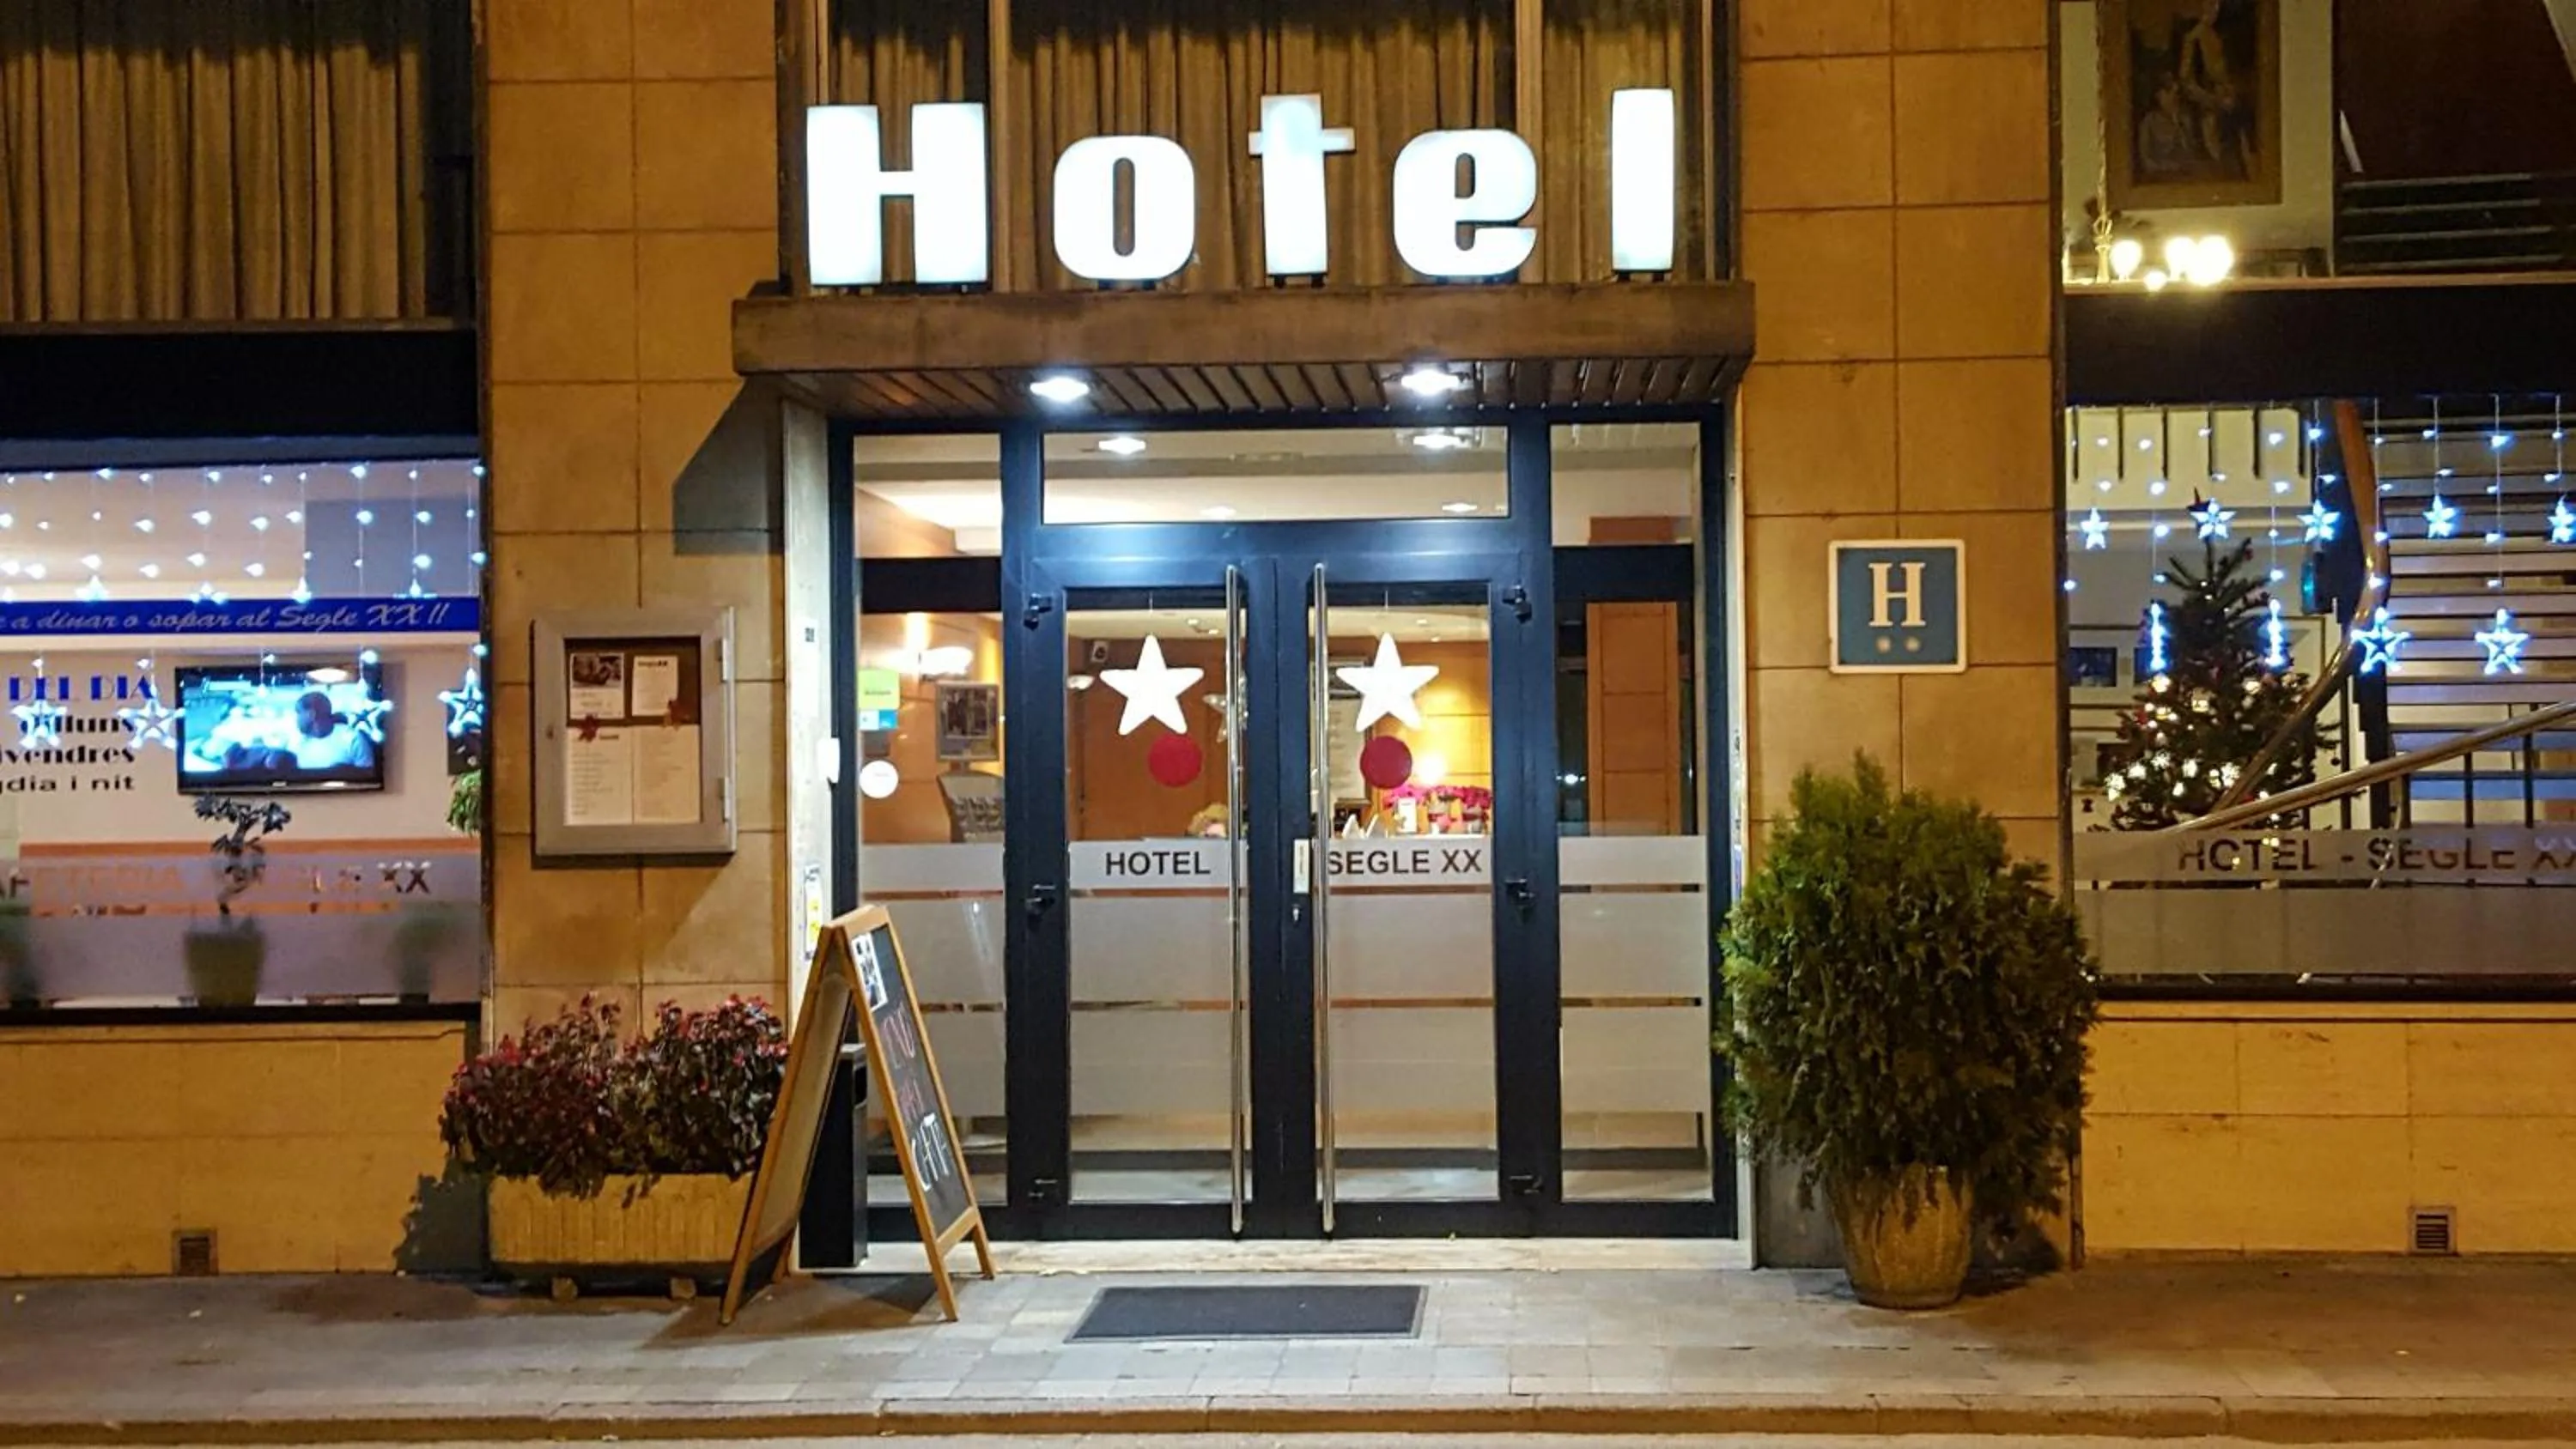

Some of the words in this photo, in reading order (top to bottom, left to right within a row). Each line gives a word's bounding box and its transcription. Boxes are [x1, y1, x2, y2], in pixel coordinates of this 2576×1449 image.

[806, 87, 1674, 285] Hotel
[1868, 562, 1927, 627] H
[11, 615, 31, 629] a
[36, 609, 120, 629] dinar
[123, 614, 140, 628] o
[148, 610, 232, 633] sopar
[235, 604, 271, 627] al
[274, 603, 358, 634] Segle
[9, 676, 82, 701] DEL
[0, 744, 136, 764] vendres
[0, 775, 57, 795] dia
[91, 775, 136, 791] nit
[1105, 851, 1211, 876] HOTEL
[1327, 849, 1431, 875] SEGLE
[1440, 848, 1482, 874] XX
[2178, 837, 2322, 872] HOTEL
[2367, 836, 2516, 871] SEGLE
